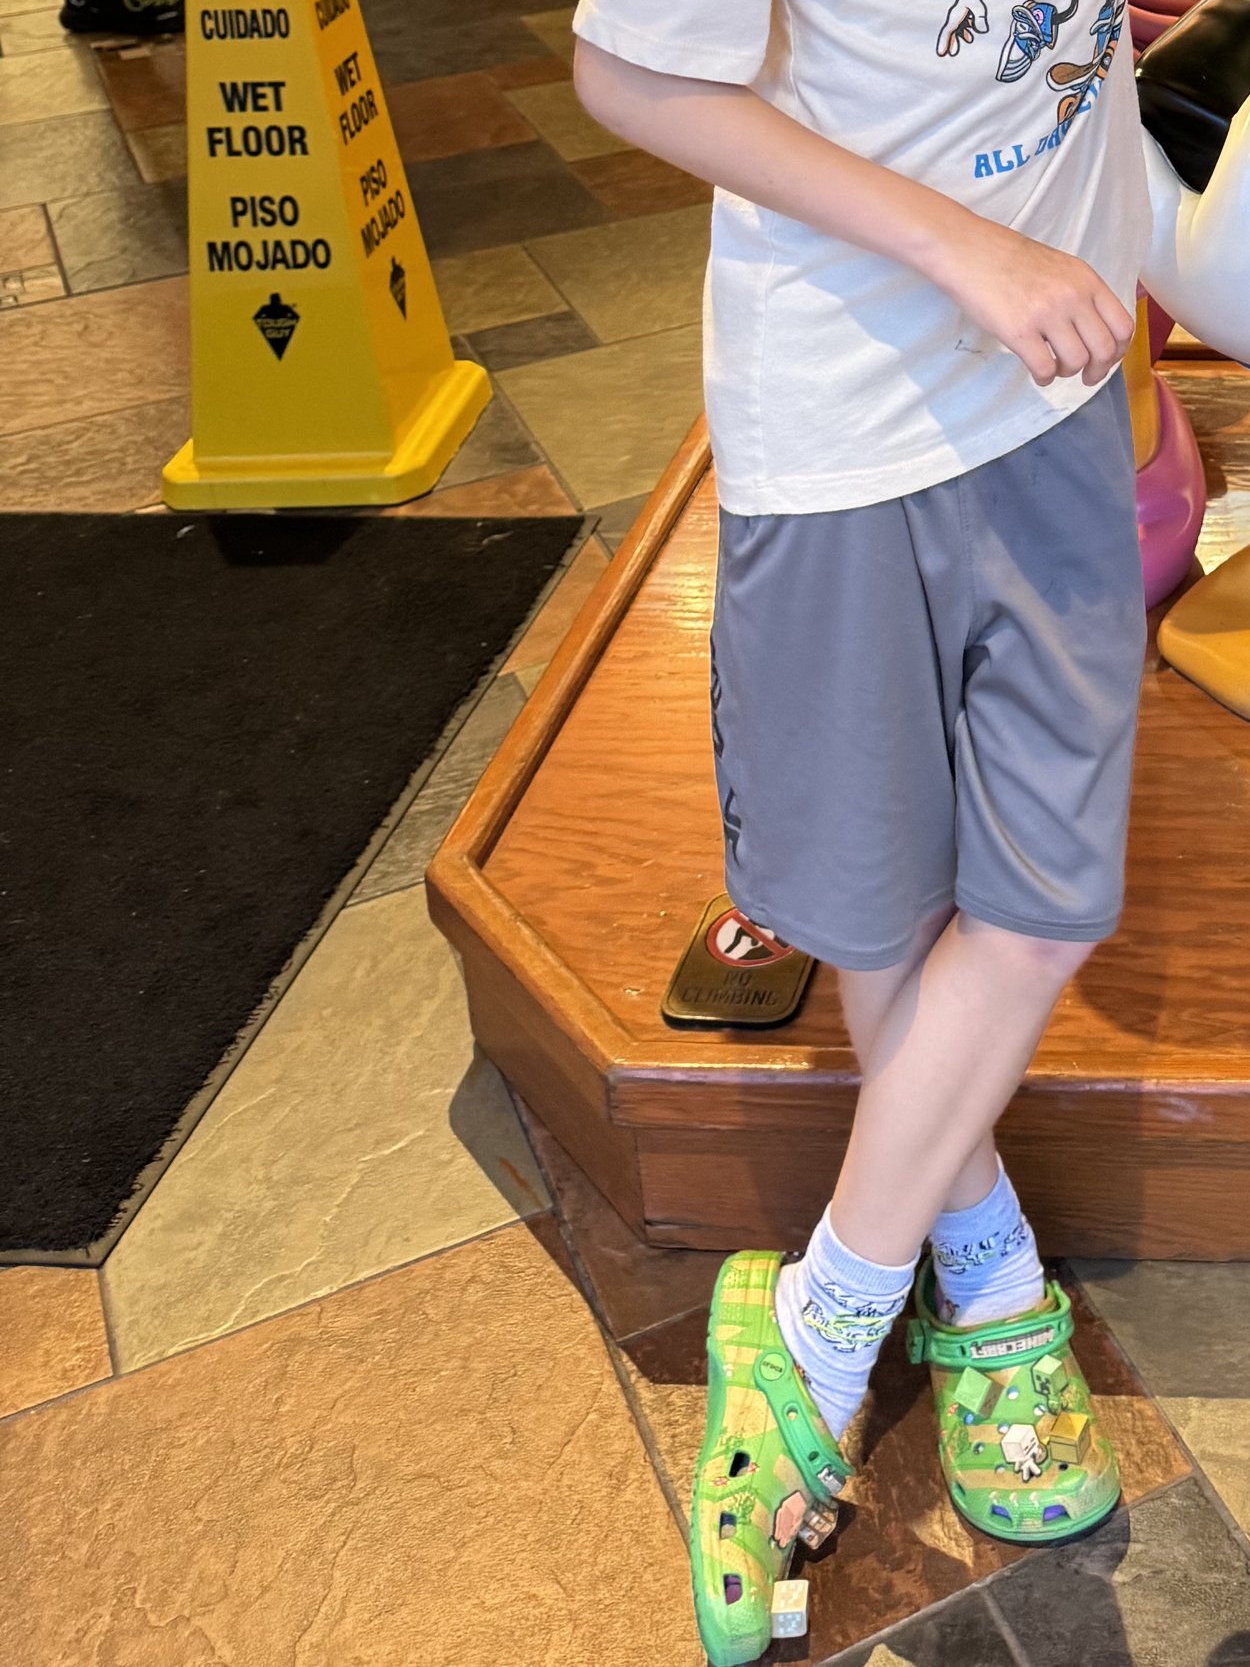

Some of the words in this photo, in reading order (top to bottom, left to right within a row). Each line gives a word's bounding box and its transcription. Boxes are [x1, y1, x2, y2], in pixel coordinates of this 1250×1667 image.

[201, 8, 290, 40] CUIDADO
[334, 51, 362, 96] WET
[219, 81, 286, 113] WET
[338, 89, 379, 146] FLOOR
[207, 125, 309, 158] FLOOR
[974, 144, 1031, 179] ALL
[359, 159, 387, 207] PISO
[230, 195, 300, 228] PISO
[360, 190, 405, 259] MOJADO
[207, 238, 332, 272] MOJADO
[722, 970, 752, 987] NO
[682, 989, 778, 1006] CLIMBING
